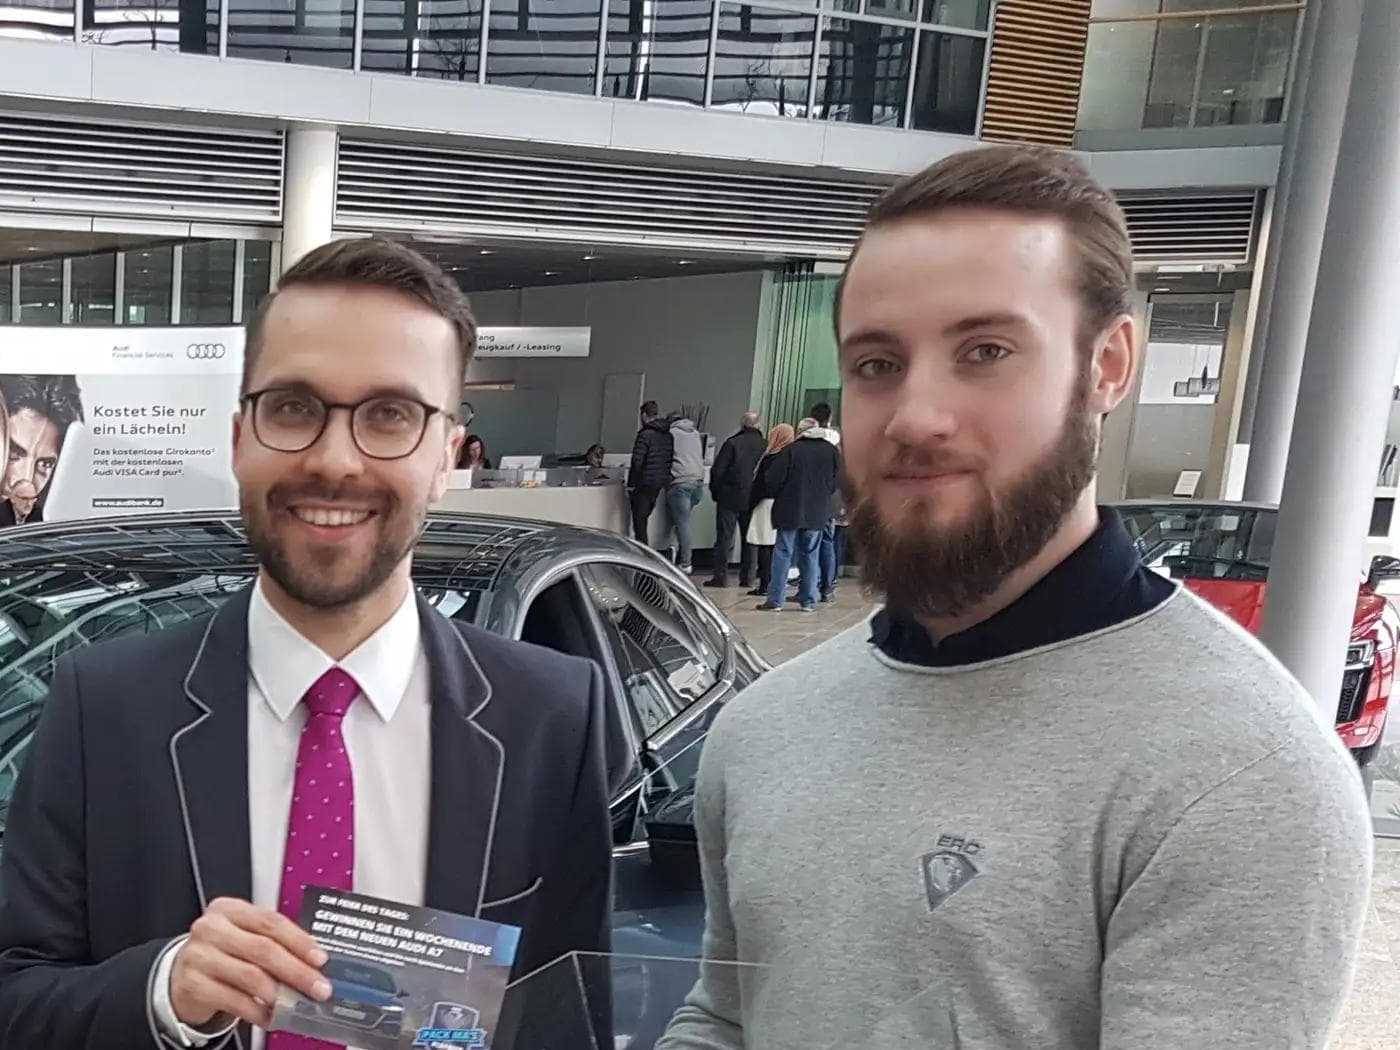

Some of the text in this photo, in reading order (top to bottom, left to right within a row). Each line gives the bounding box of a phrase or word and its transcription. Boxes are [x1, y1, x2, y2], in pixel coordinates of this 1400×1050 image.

[478, 334, 495, 342] ang
[478, 343, 515, 352] eugkauf
[93, 405, 207, 417] Kostet Sie nur
[93, 423, 187, 435] ein Lächeln!
[93, 448, 110, 456] Das
[112, 448, 164, 456] kostenlose
[93, 458, 184, 466] mit der kostenlosen
[93, 468, 114, 476] Audi
[138, 468, 161, 476] Card
[312, 921, 333, 934] MIT
[333, 926, 359, 940] DEM
[360, 930, 398, 949] NEUEN
[399, 940, 428, 955] AUDI
[428, 945, 445, 958] A7
[375, 922, 394, 934] SIE
[394, 926, 414, 939] EIN
[414, 930, 493, 956] WOCHENENDE
